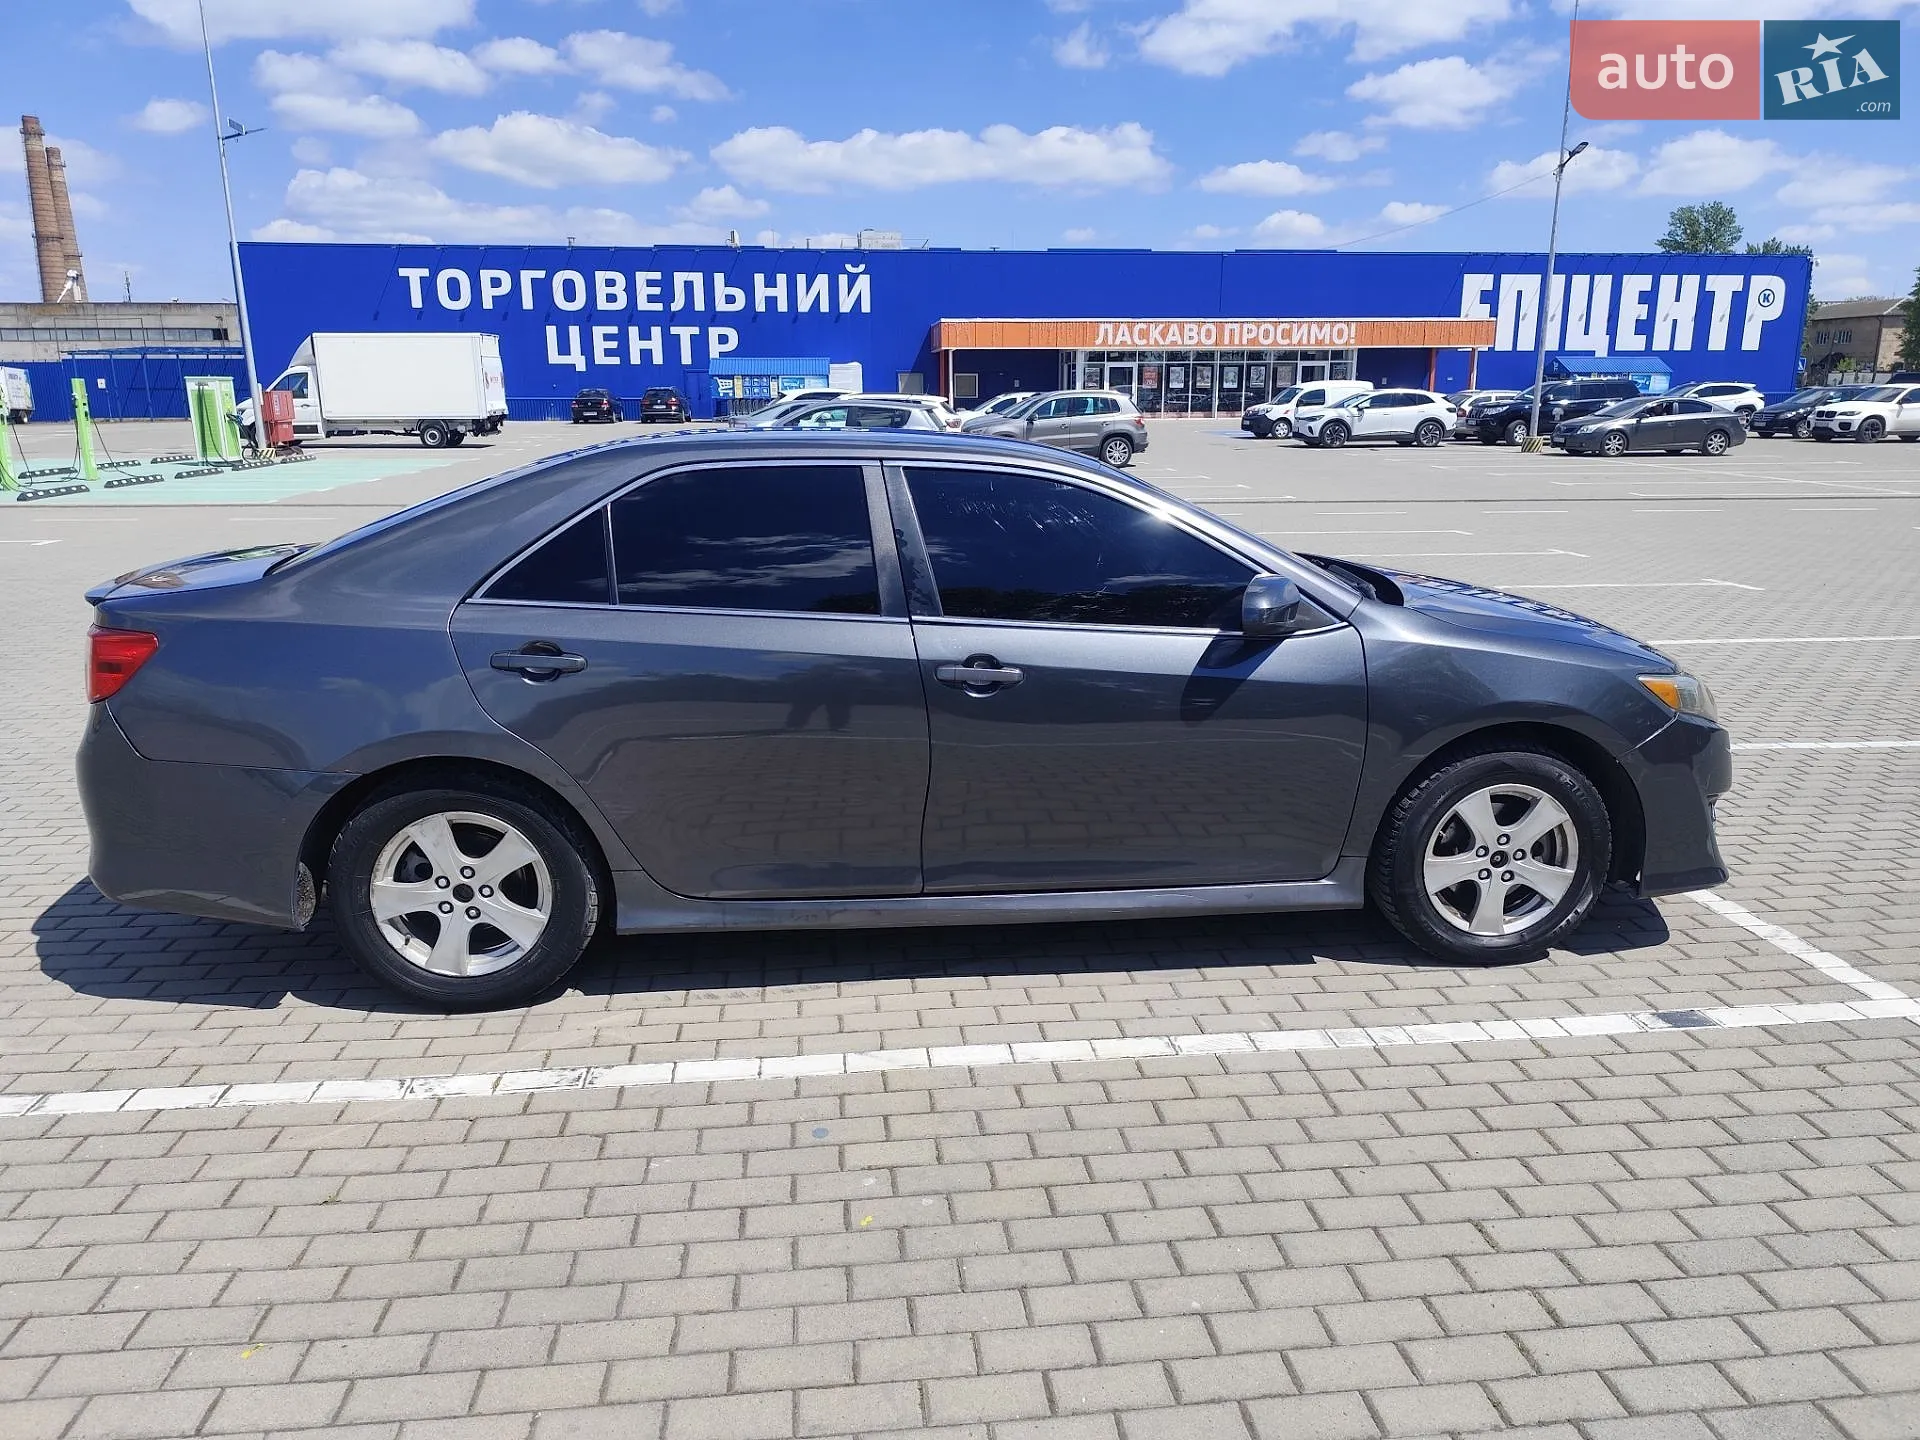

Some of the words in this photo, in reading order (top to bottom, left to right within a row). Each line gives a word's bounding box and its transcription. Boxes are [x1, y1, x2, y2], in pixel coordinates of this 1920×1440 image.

[398, 264, 871, 314] ТОРГОВЕЛЬНИЙ
[545, 325, 739, 371] ЦЕНТР
[1095, 322, 1218, 346] ЛАСКАВО
[1223, 322, 1356, 346] ПРОСИМО!
